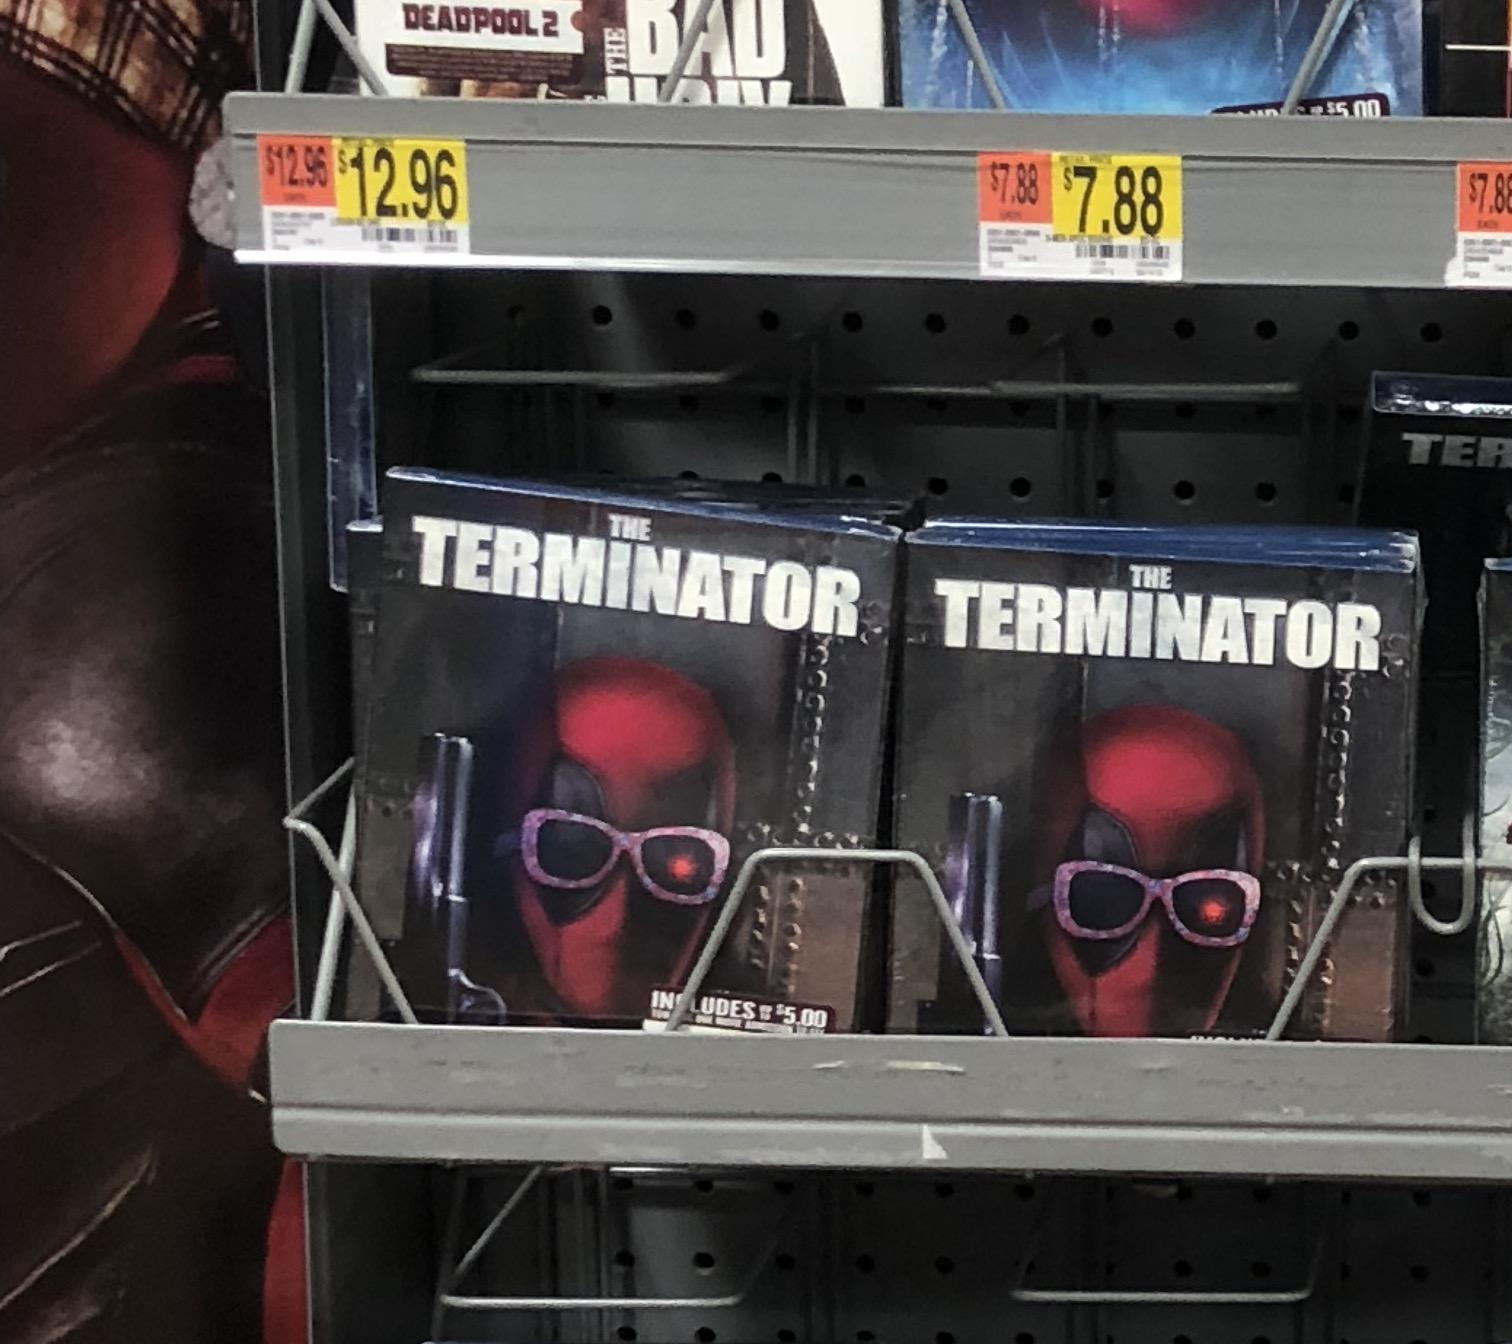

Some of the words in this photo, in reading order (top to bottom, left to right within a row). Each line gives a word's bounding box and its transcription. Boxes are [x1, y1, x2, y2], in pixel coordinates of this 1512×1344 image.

[402, 3, 538, 37] DEADPOOL
[541, 10, 559, 38] 2
[266, 146, 328, 187] $12.96
[338, 147, 458, 219] $12.96
[990, 162, 1038, 205] $7.88
[1063, 166, 1163, 236] $7.88
[609, 513, 651, 542] THE
[412, 515, 861, 637] TERMINATOR
[1129, 564, 1172, 590] THE
[934, 578, 1382, 672] TERMINATOR
[776, 1004, 828, 1028] $5.00
